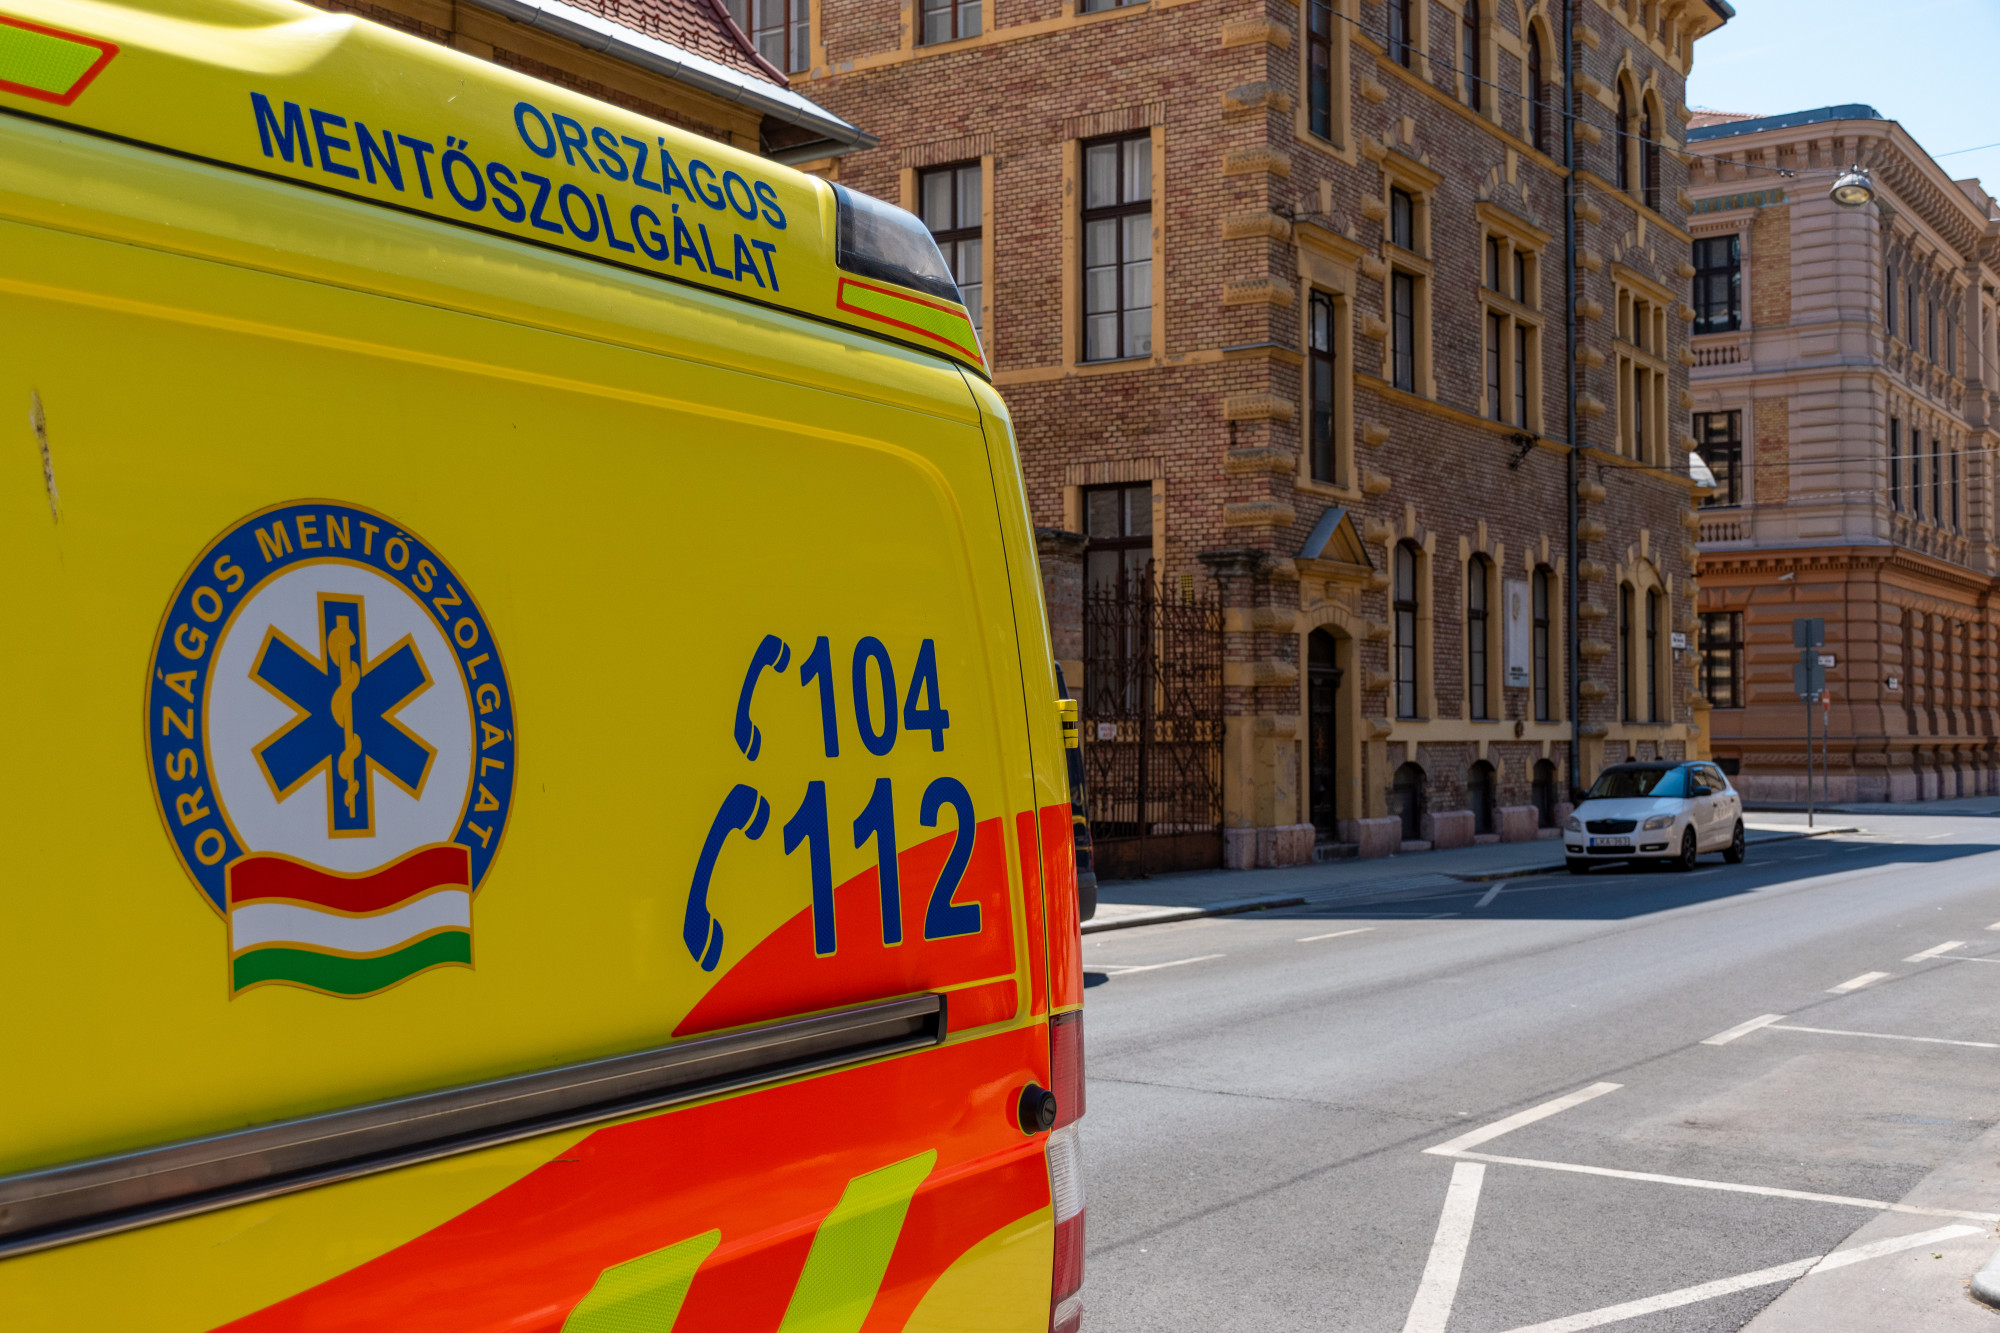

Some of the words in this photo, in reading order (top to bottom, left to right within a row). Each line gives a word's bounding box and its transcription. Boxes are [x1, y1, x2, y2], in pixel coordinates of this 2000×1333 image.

[250, 91, 780, 292] MENTŐSZOLGÁLAT
[513, 101, 787, 231] ORSZÁGOS
[157, 554, 245, 866] ORSZÁGOS
[254, 514, 513, 849] MENTŐSZOLGÁLAT
[800, 635, 950, 758] 104
[783, 776, 981, 958] 112
